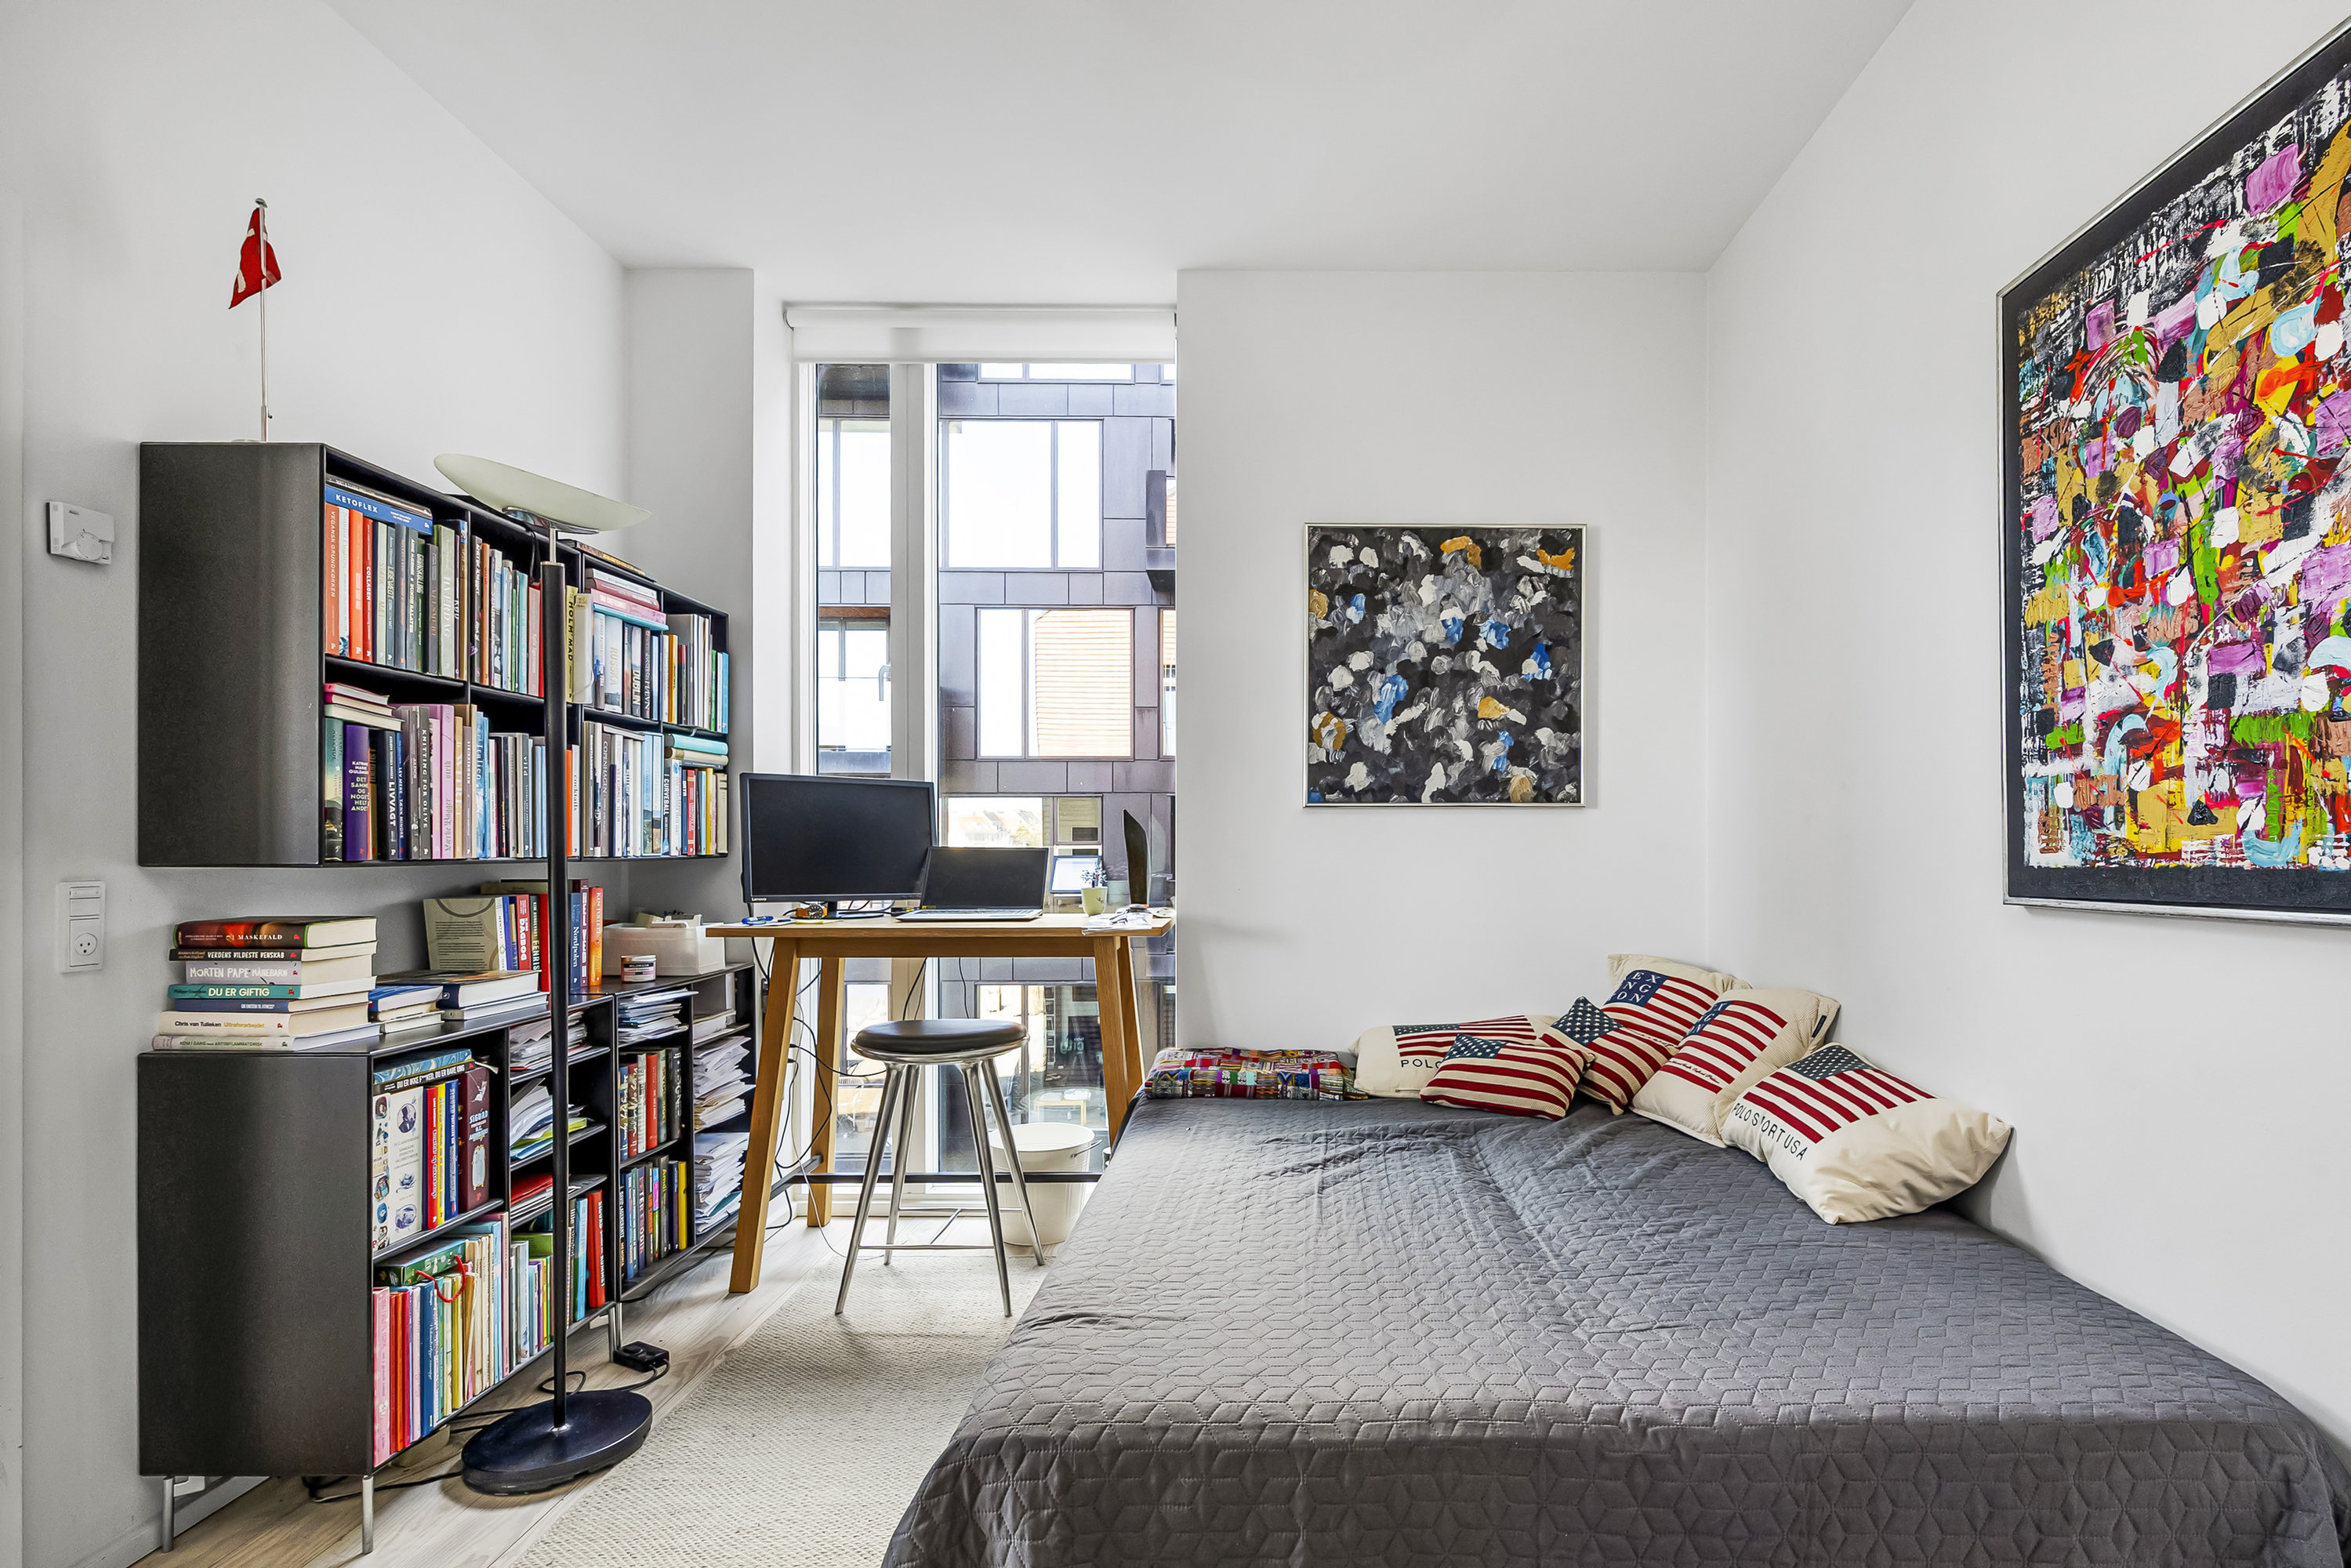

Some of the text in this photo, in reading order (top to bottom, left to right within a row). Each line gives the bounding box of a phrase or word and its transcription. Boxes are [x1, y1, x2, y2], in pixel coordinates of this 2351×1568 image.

[335, 494, 379, 514] KETOFLEX
[443, 576, 452, 637] HVERDAG
[610, 647, 619, 685] RUSSKA
[632, 670, 640, 705] DUBLIN
[189, 967, 288, 978] MORTEN PAPE MÅNEBARN
[208, 988, 223, 996] DU
[225, 988, 237, 996] ER
[238, 988, 270, 997] GIFTIG
[447, 1068, 457, 1076] BARE
[456, 1065, 465, 1074] UNG
[1731, 1102, 1752, 1122] POLO
[1783, 1134, 1808, 1161] USA
